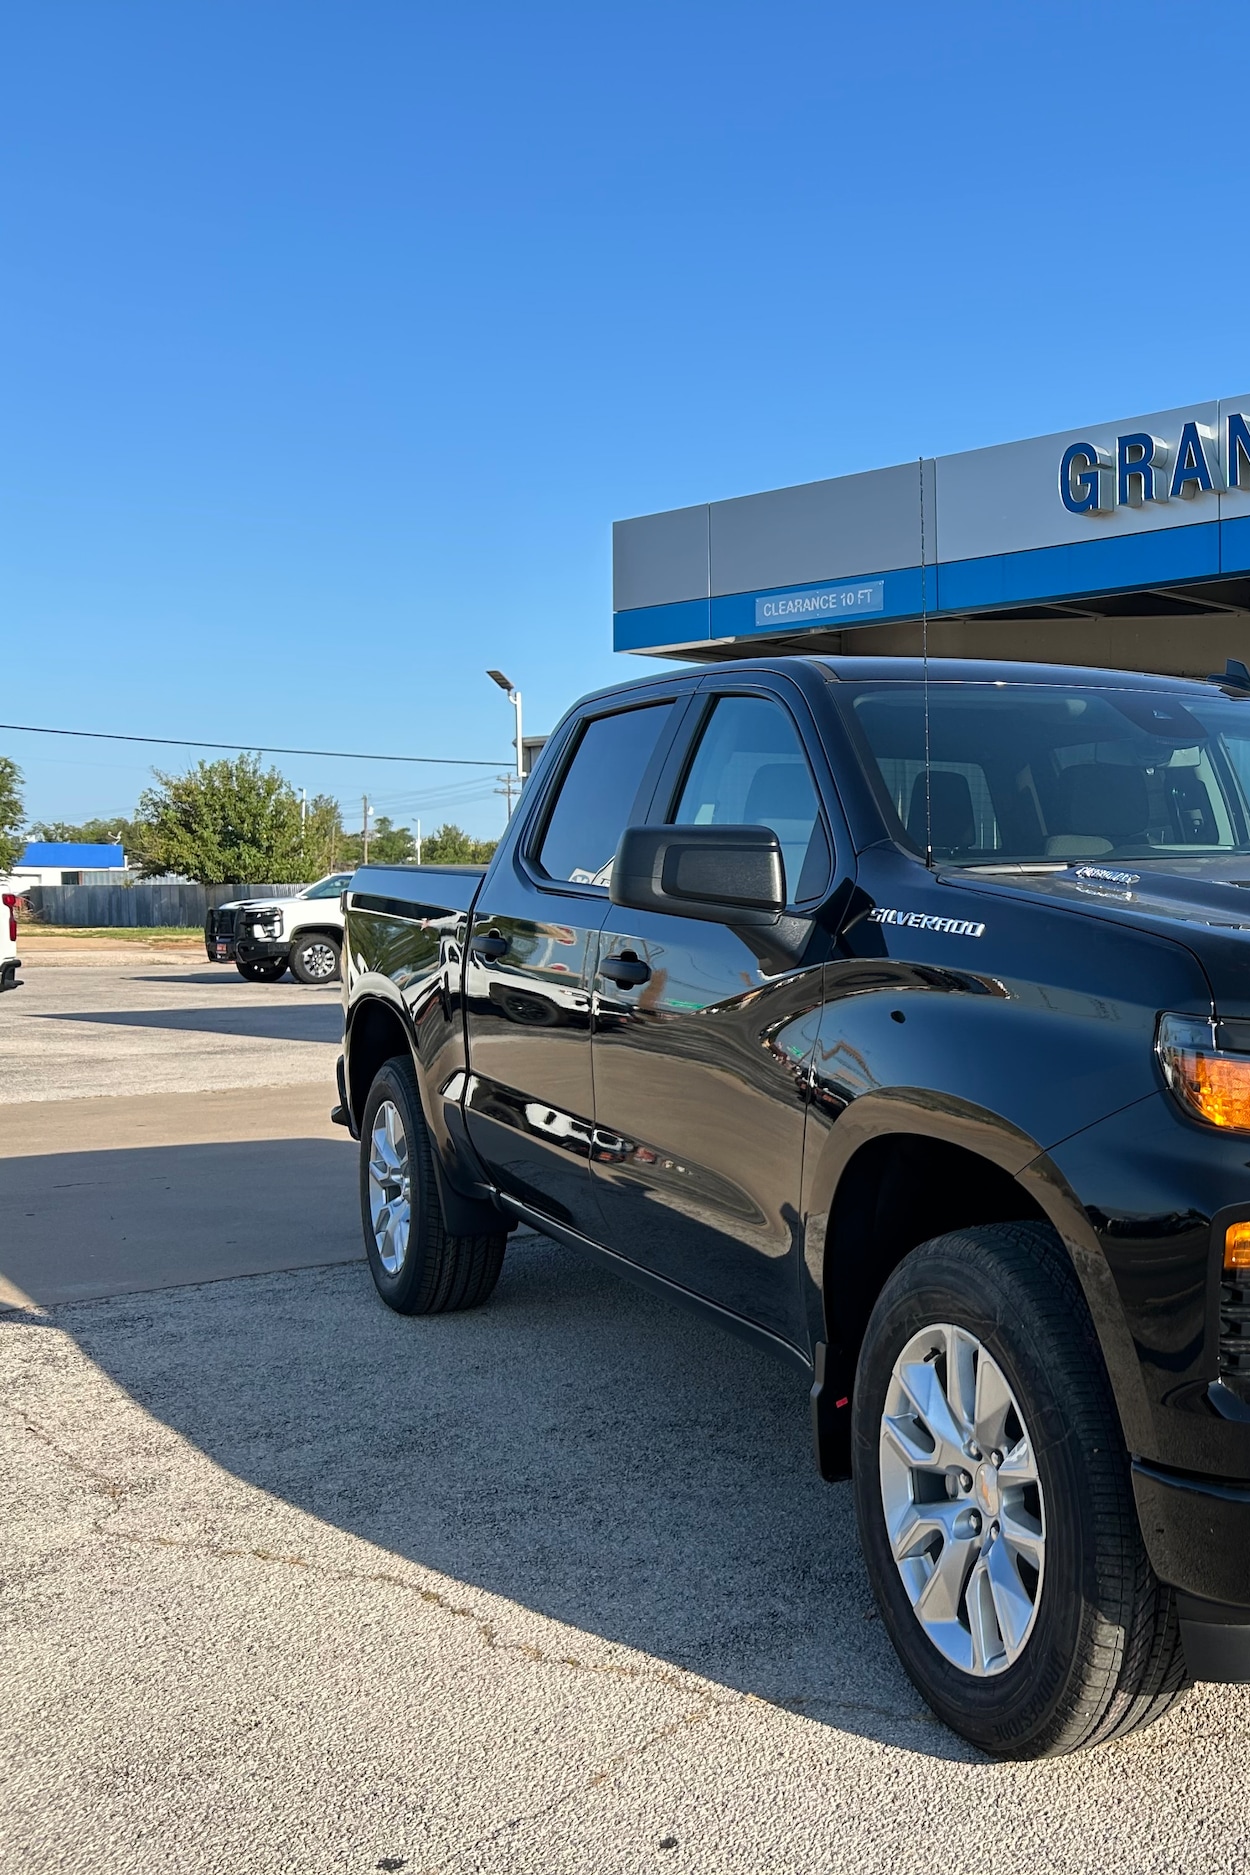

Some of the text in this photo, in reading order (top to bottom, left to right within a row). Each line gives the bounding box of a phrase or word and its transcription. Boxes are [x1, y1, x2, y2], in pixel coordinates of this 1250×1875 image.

[763, 588, 873, 617] CLEARANCE 10 FT
[867, 907, 986, 938] SILVERADO
